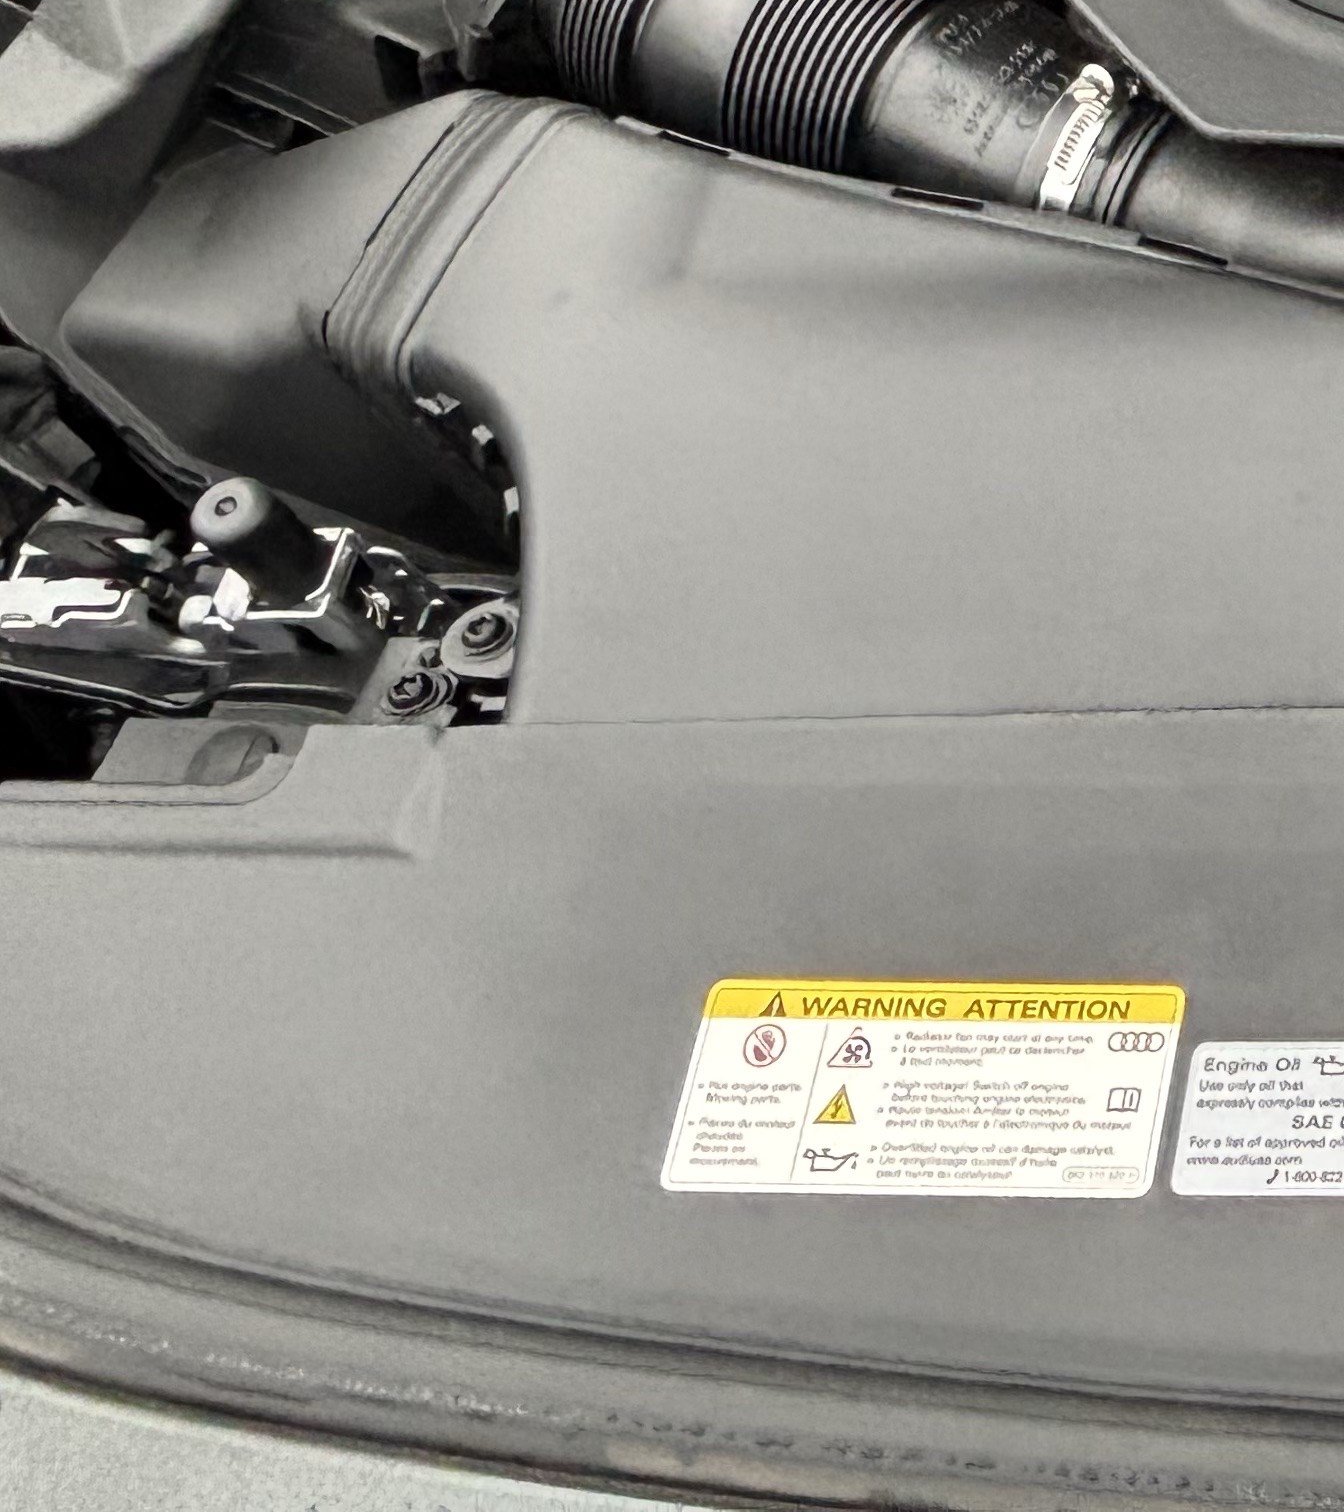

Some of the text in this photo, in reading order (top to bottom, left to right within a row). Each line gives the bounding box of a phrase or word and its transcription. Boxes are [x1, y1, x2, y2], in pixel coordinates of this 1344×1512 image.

[802, 997, 1131, 1020] WARNING ATTENTION
[1291, 1115, 1333, 1129] SAE
